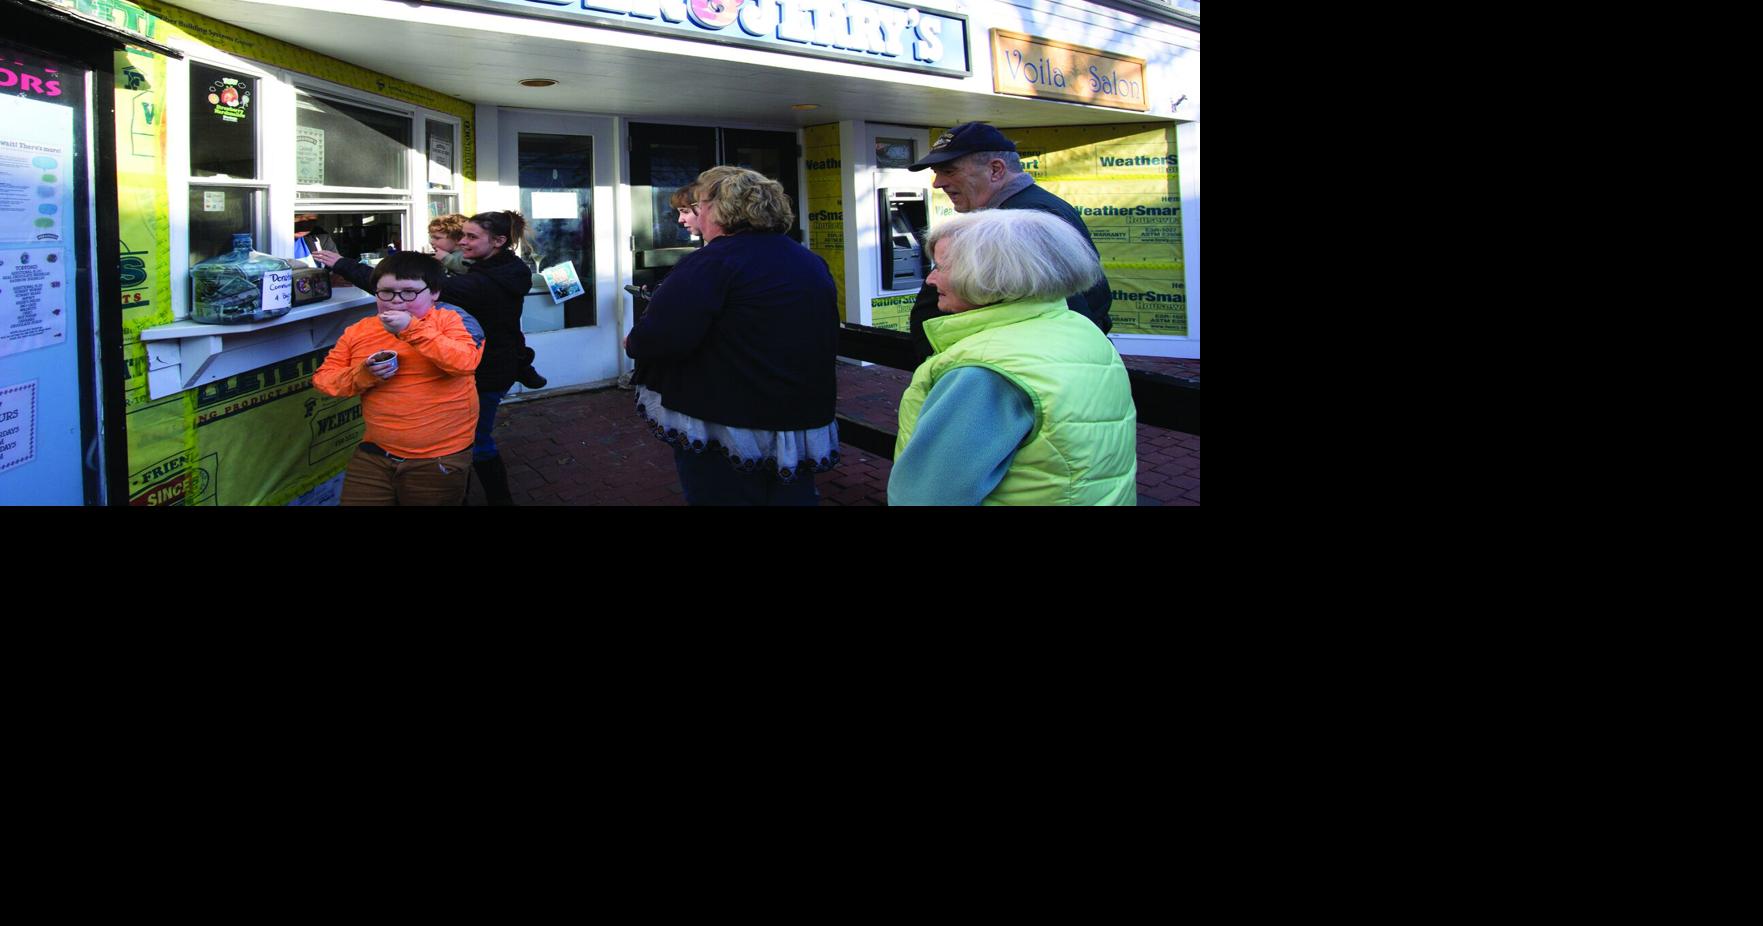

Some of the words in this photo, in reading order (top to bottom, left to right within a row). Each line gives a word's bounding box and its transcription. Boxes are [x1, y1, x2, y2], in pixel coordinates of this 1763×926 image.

[0, 67, 62, 97] ORS
[1005, 49, 1066, 88] Voila
[1089, 65, 1141, 100] Salon
[1100, 154, 1177, 168] WeatherS
[224, 388, 283, 416] PRODUCT
[147, 478, 191, 506] SINCE
